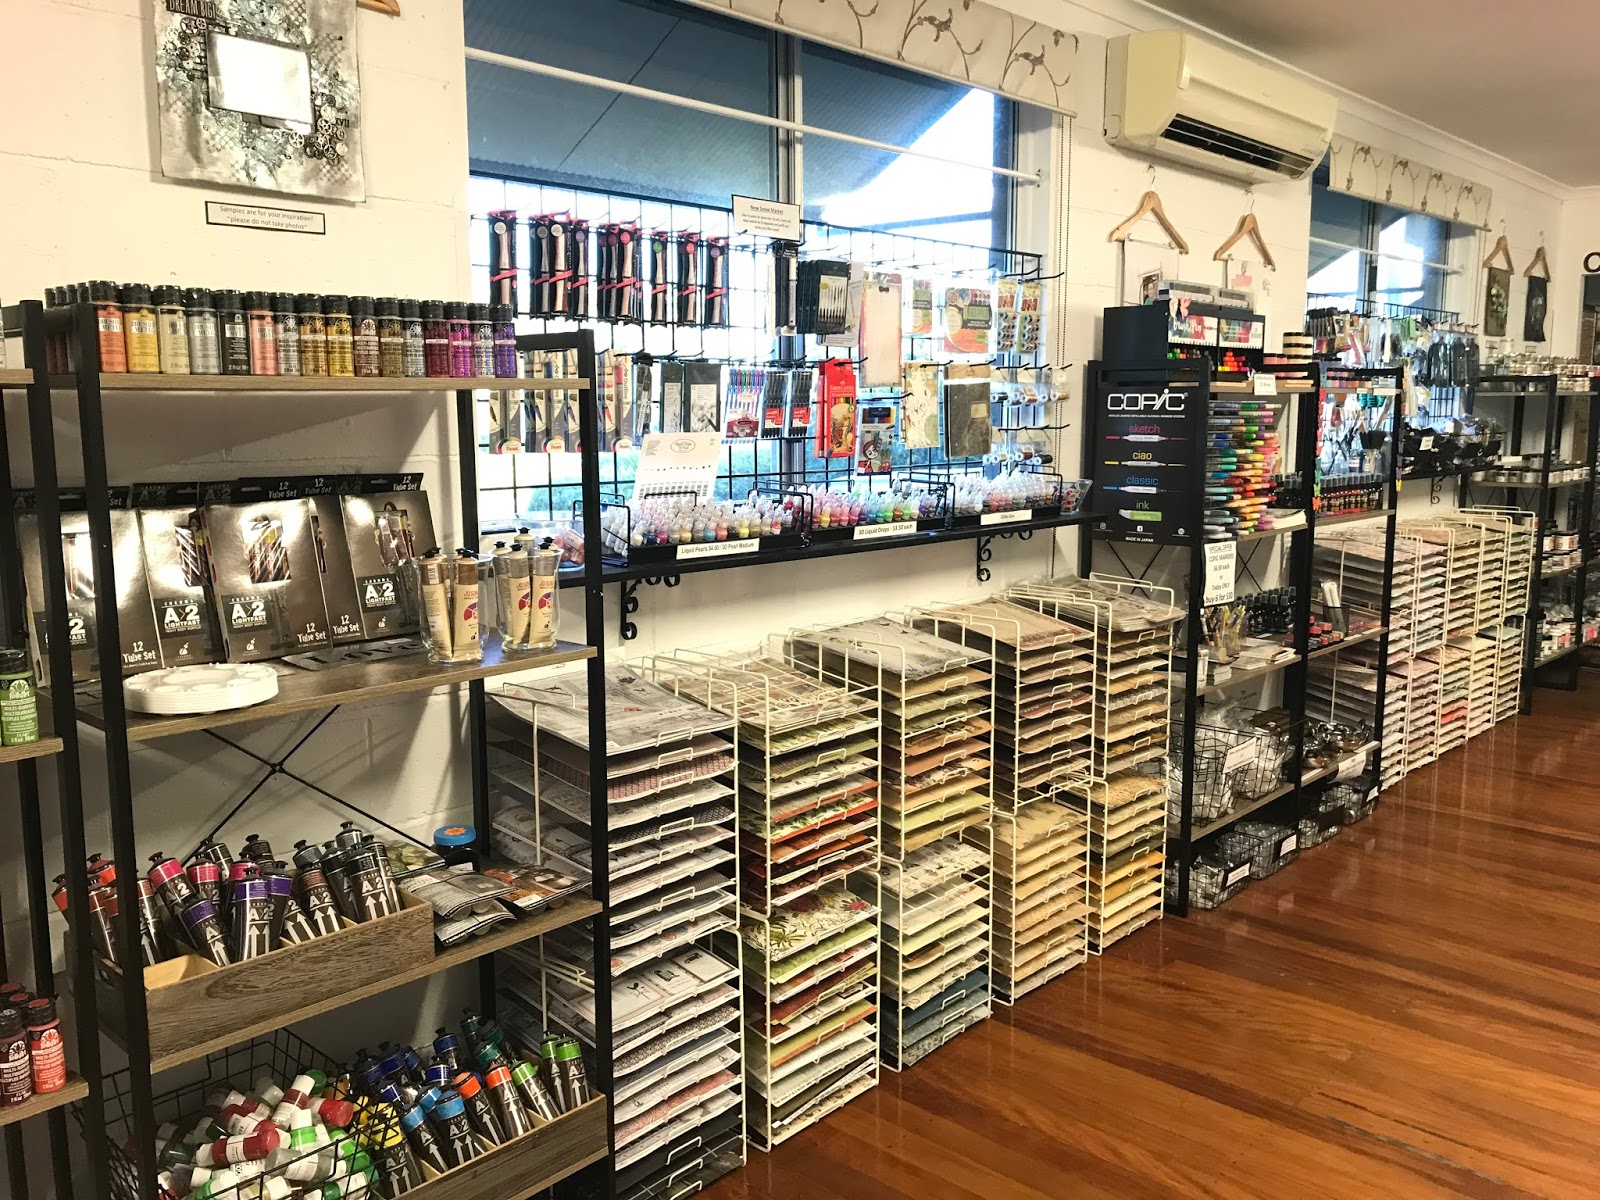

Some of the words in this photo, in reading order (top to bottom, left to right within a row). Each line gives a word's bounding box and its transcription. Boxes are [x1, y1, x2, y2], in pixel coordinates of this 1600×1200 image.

[220, 206, 245, 215] Samples
[282, 213, 314, 221] inspiration!
[1129, 424, 1160, 434] sketch
[1132, 450, 1152, 460] ciao
[314, 478, 323, 487] 12
[1126, 475, 1159, 485] classic
[279, 481, 289, 490] 12
[305, 486, 320, 494] Tube
[321, 485, 331, 493] Set
[393, 483, 407, 491] Tube
[269, 490, 286, 499] Tube
[287, 488, 297, 497] Set
[109, 497, 122, 506] Set
[1136, 500, 1150, 509] ink
[865, 528, 877, 536] Liquid
[878, 526, 890, 534] Drops
[366, 596, 395, 604] LIGHTFAST
[165, 619, 200, 628] LIGHTFAST
[232, 616, 267, 625] LIGHTFAST
[341, 614, 350, 625] 12
[306, 622, 316, 633] 12
[333, 625, 349, 635] Tube
[349, 623, 360, 632] Set
[297, 633, 314, 643] Tube
[315, 631, 326, 640] Set
[133, 641, 143, 652] 12
[123, 653, 142, 663] Tube
[144, 650, 156, 660] Set
